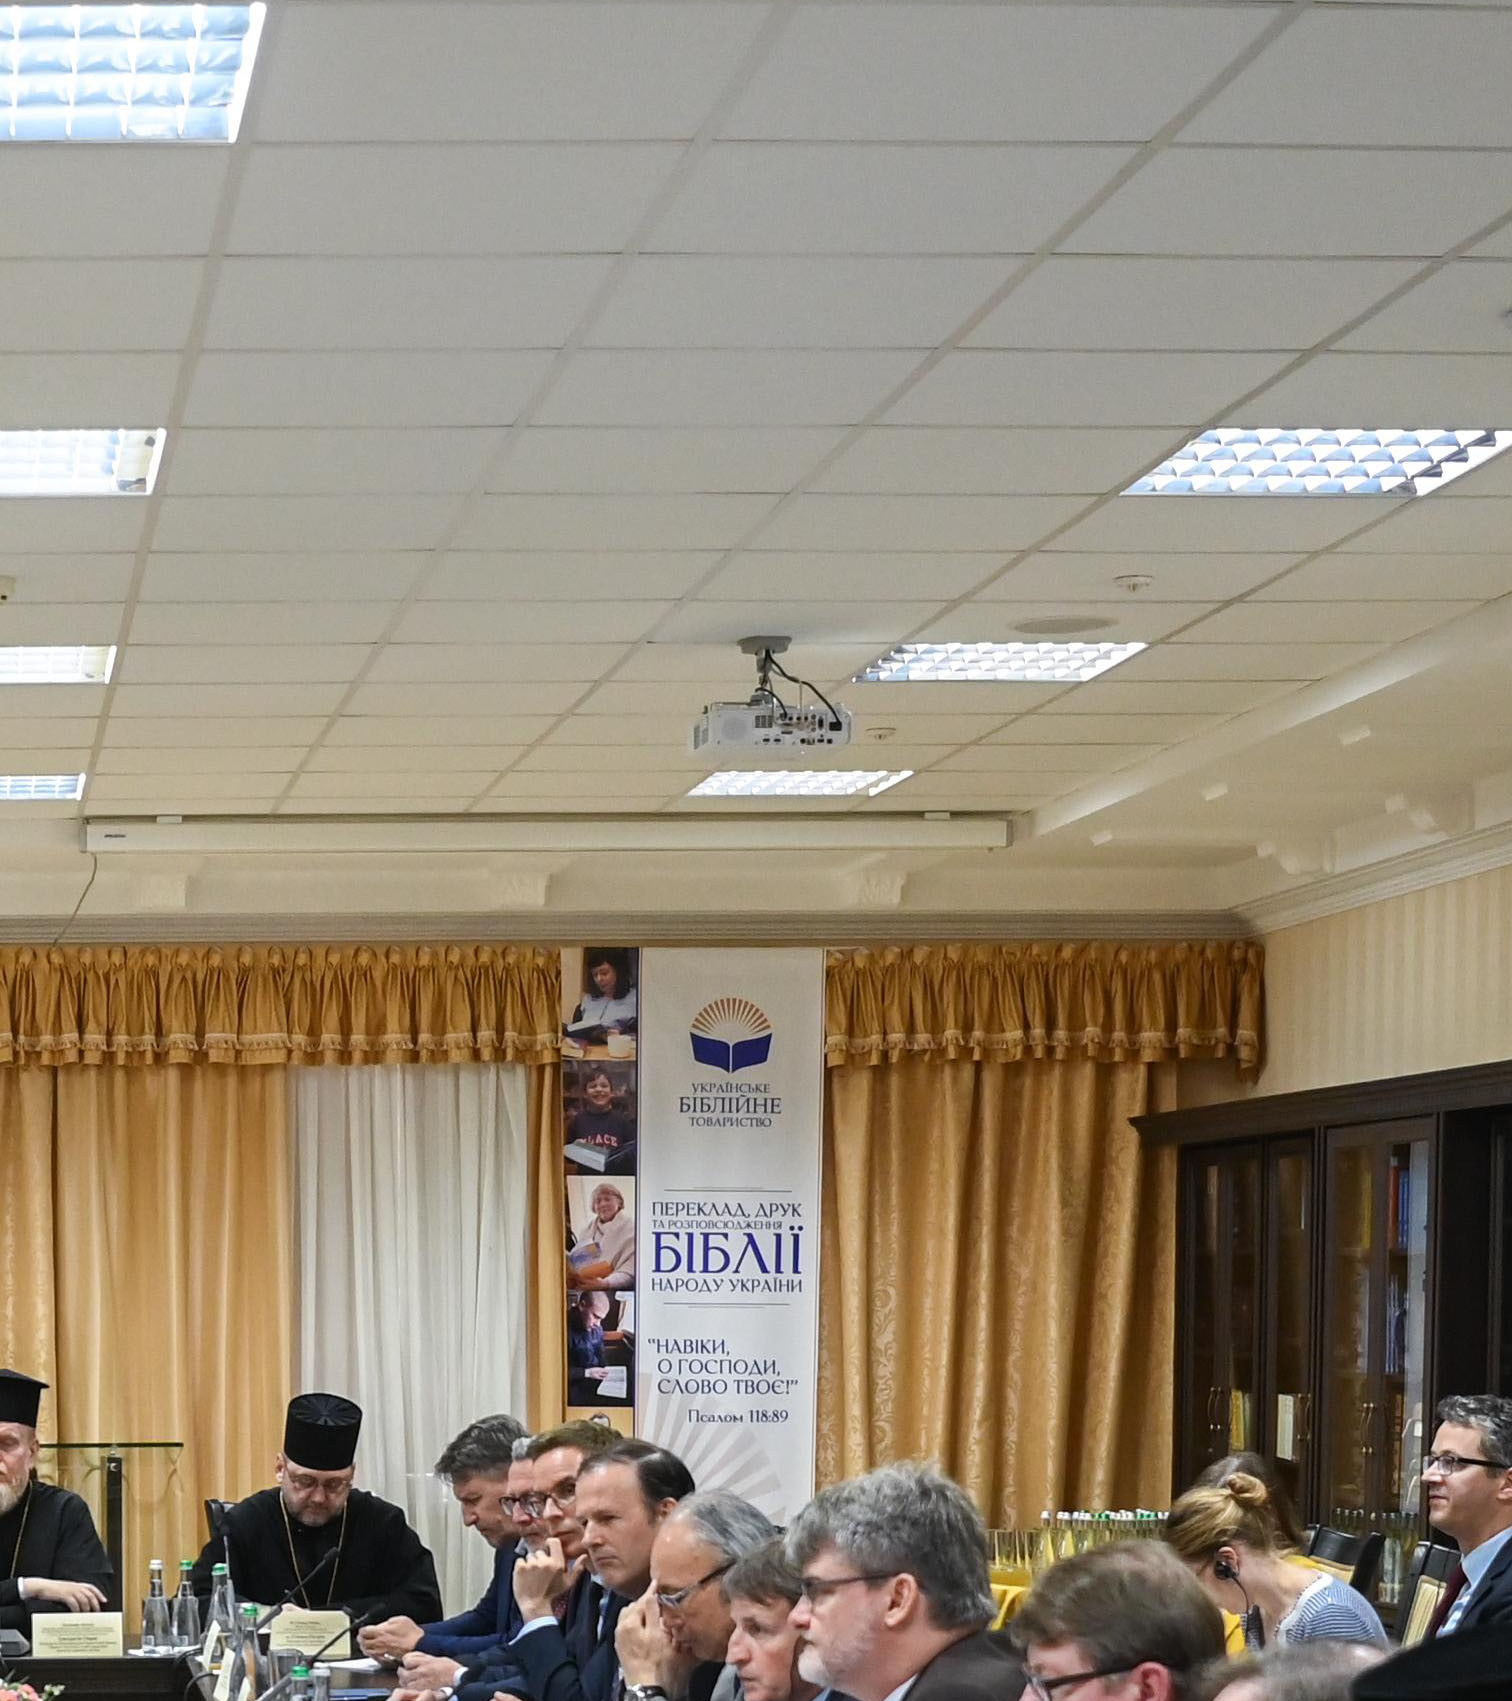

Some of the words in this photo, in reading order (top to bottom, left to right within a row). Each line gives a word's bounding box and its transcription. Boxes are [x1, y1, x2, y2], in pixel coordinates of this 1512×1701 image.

[692, 1081, 770, 1094] УКРАЇНСЬКЕ
[679, 1095, 782, 1114] БІБЛІЙНЕ
[689, 1116, 772, 1128] ТОВАРИСТВО
[652, 1201, 751, 1218] ПЕРЕКЛАД,
[755, 1202, 802, 1218] ДРУК
[652, 1219, 666, 1229] ТА
[668, 1219, 783, 1230] РОЗПОВСЮДЖЕННЯ
[651, 1225, 804, 1274] БІБЛІЇ
[651, 1277, 724, 1292] НАРОДУ
[729, 1277, 803, 1293] УКРАЇНИ
[657, 1358, 673, 1375] О
[678, 1359, 781, 1376] ГОСПОДИ,
[657, 1378, 728, 1395] СЛОВО
[688, 1408, 744, 1423] Псалом
[749, 1409, 789, 1423] 118:89
